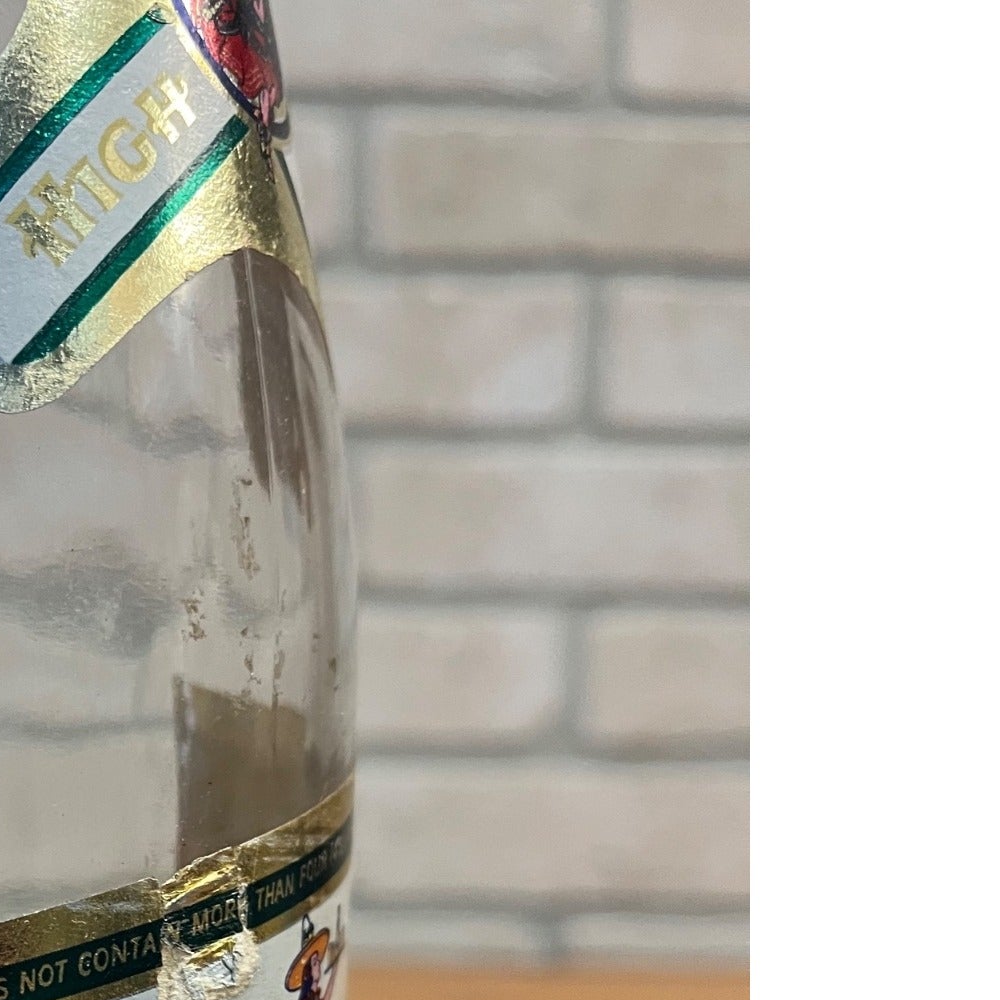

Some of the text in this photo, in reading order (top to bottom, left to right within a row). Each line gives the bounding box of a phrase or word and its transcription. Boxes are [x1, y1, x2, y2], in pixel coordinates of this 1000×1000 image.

[5, 71, 197, 268] HIGH
[19, 959, 68, 995] NOT
[192, 898, 247, 936] MOR
[255, 878, 296, 912] THAN
